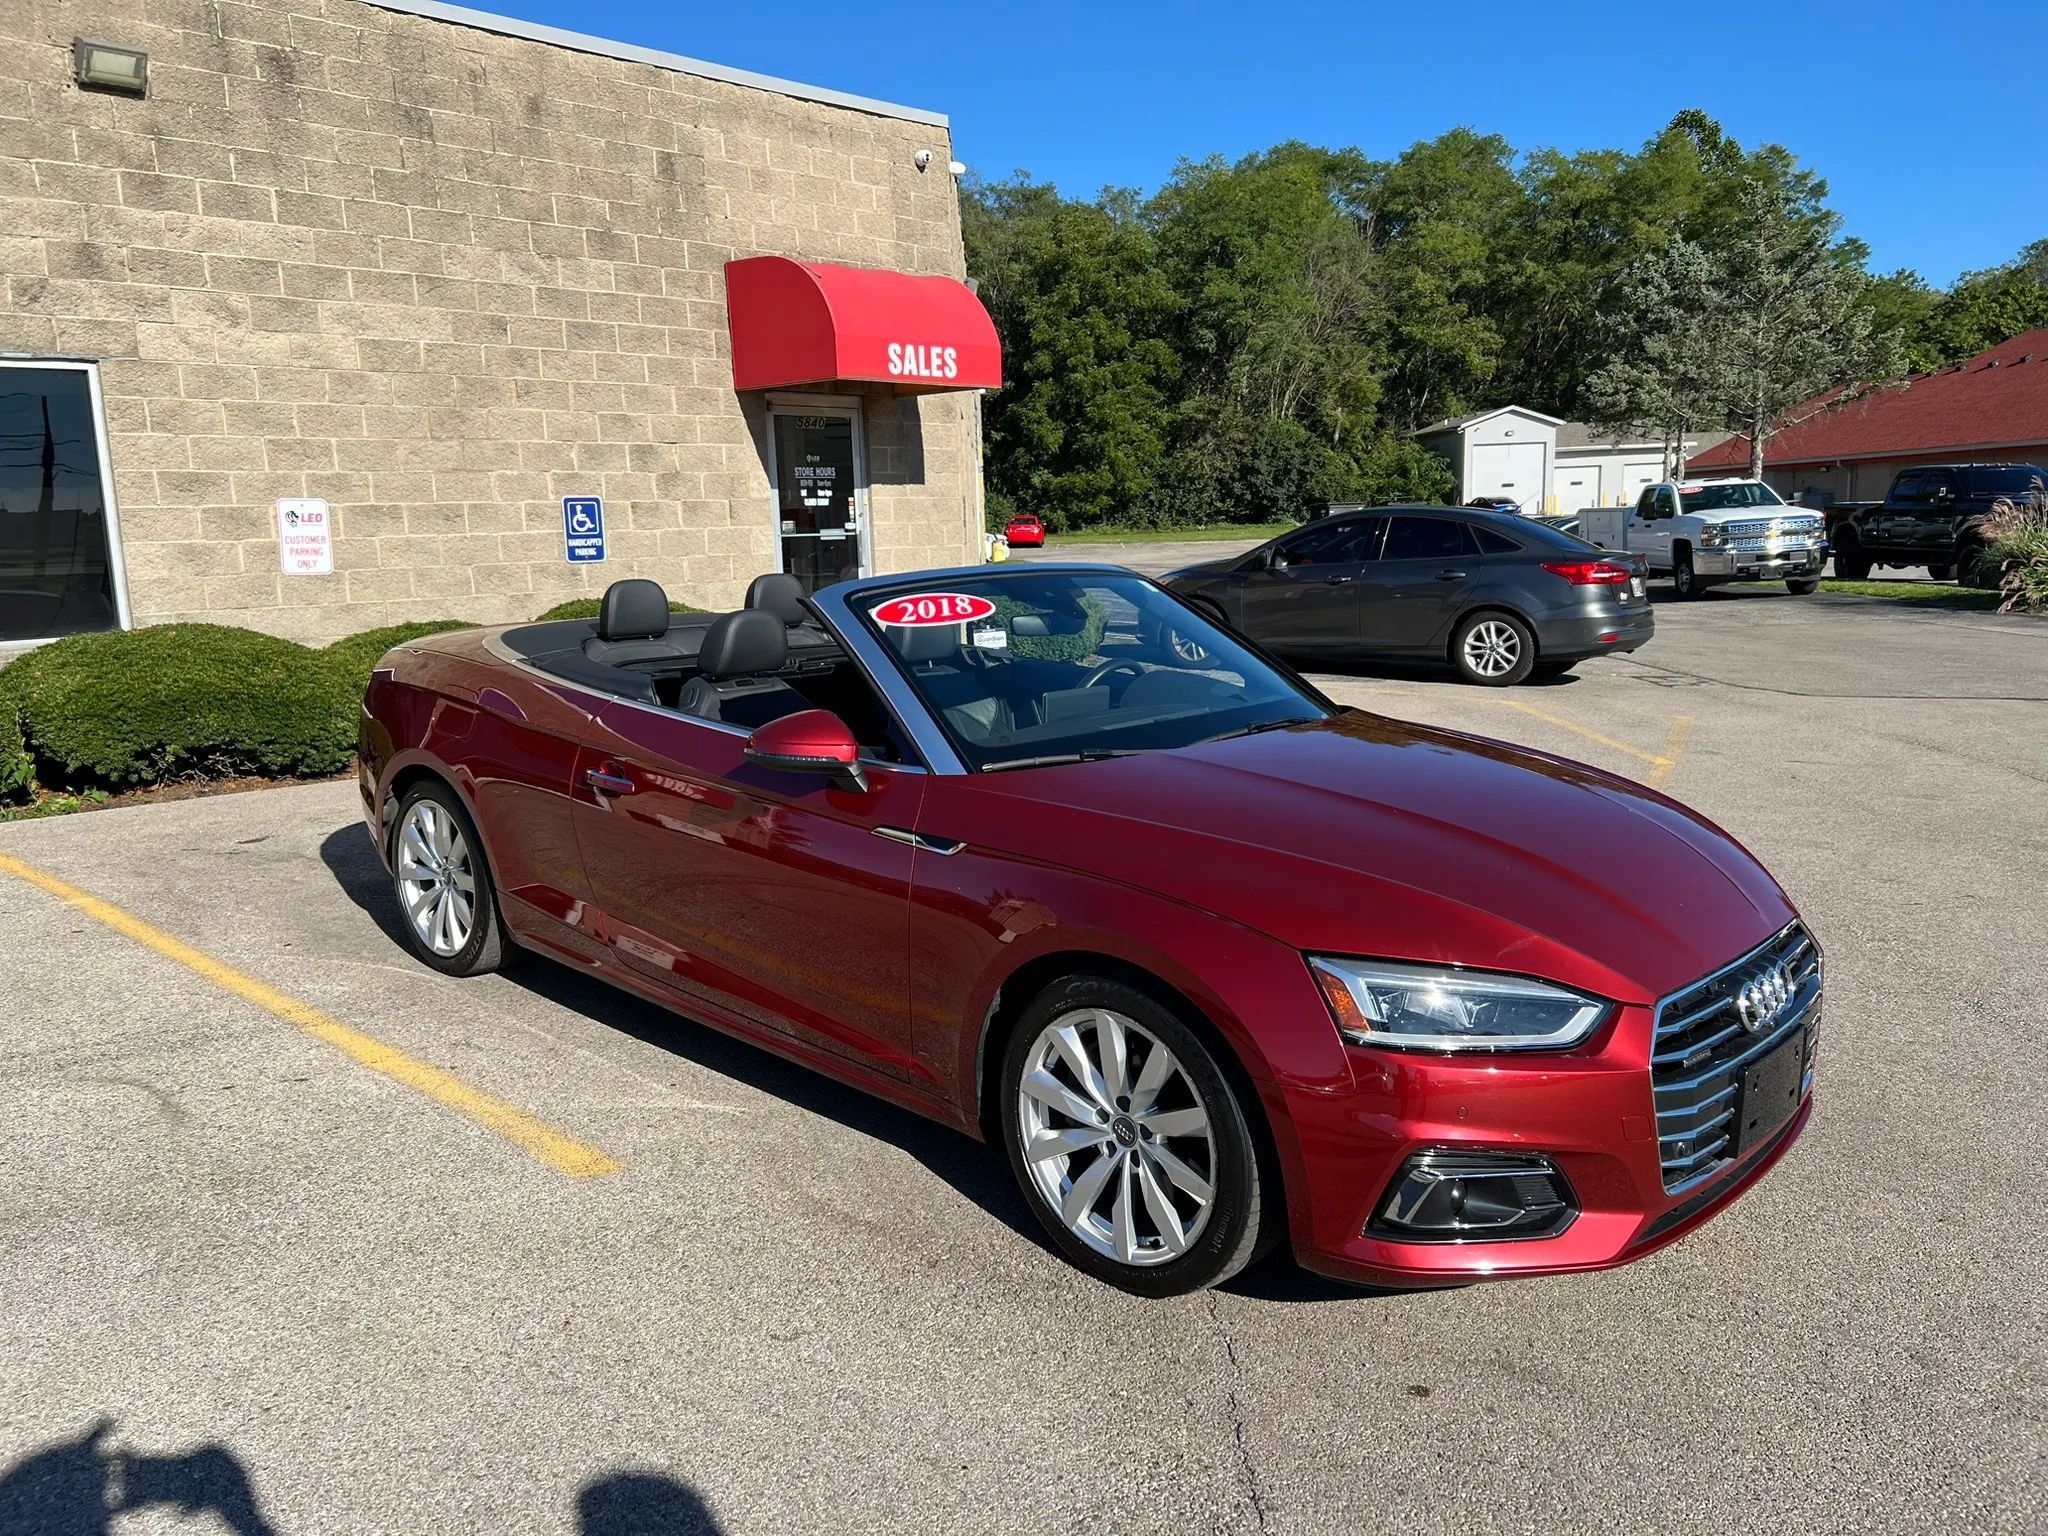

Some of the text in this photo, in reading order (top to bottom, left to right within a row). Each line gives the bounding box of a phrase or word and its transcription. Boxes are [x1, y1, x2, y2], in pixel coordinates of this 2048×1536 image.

[888, 343, 957, 378] SALES
[797, 417, 826, 429] 5840
[794, 467, 836, 476] STORE HOURS
[301, 513, 322, 522] LEO
[285, 535, 326, 545] CUSTOMER
[290, 547, 323, 557] PARKING
[575, 548, 597, 556] PARKING
[297, 560, 317, 569] ONLY
[898, 596, 973, 623] 2018
